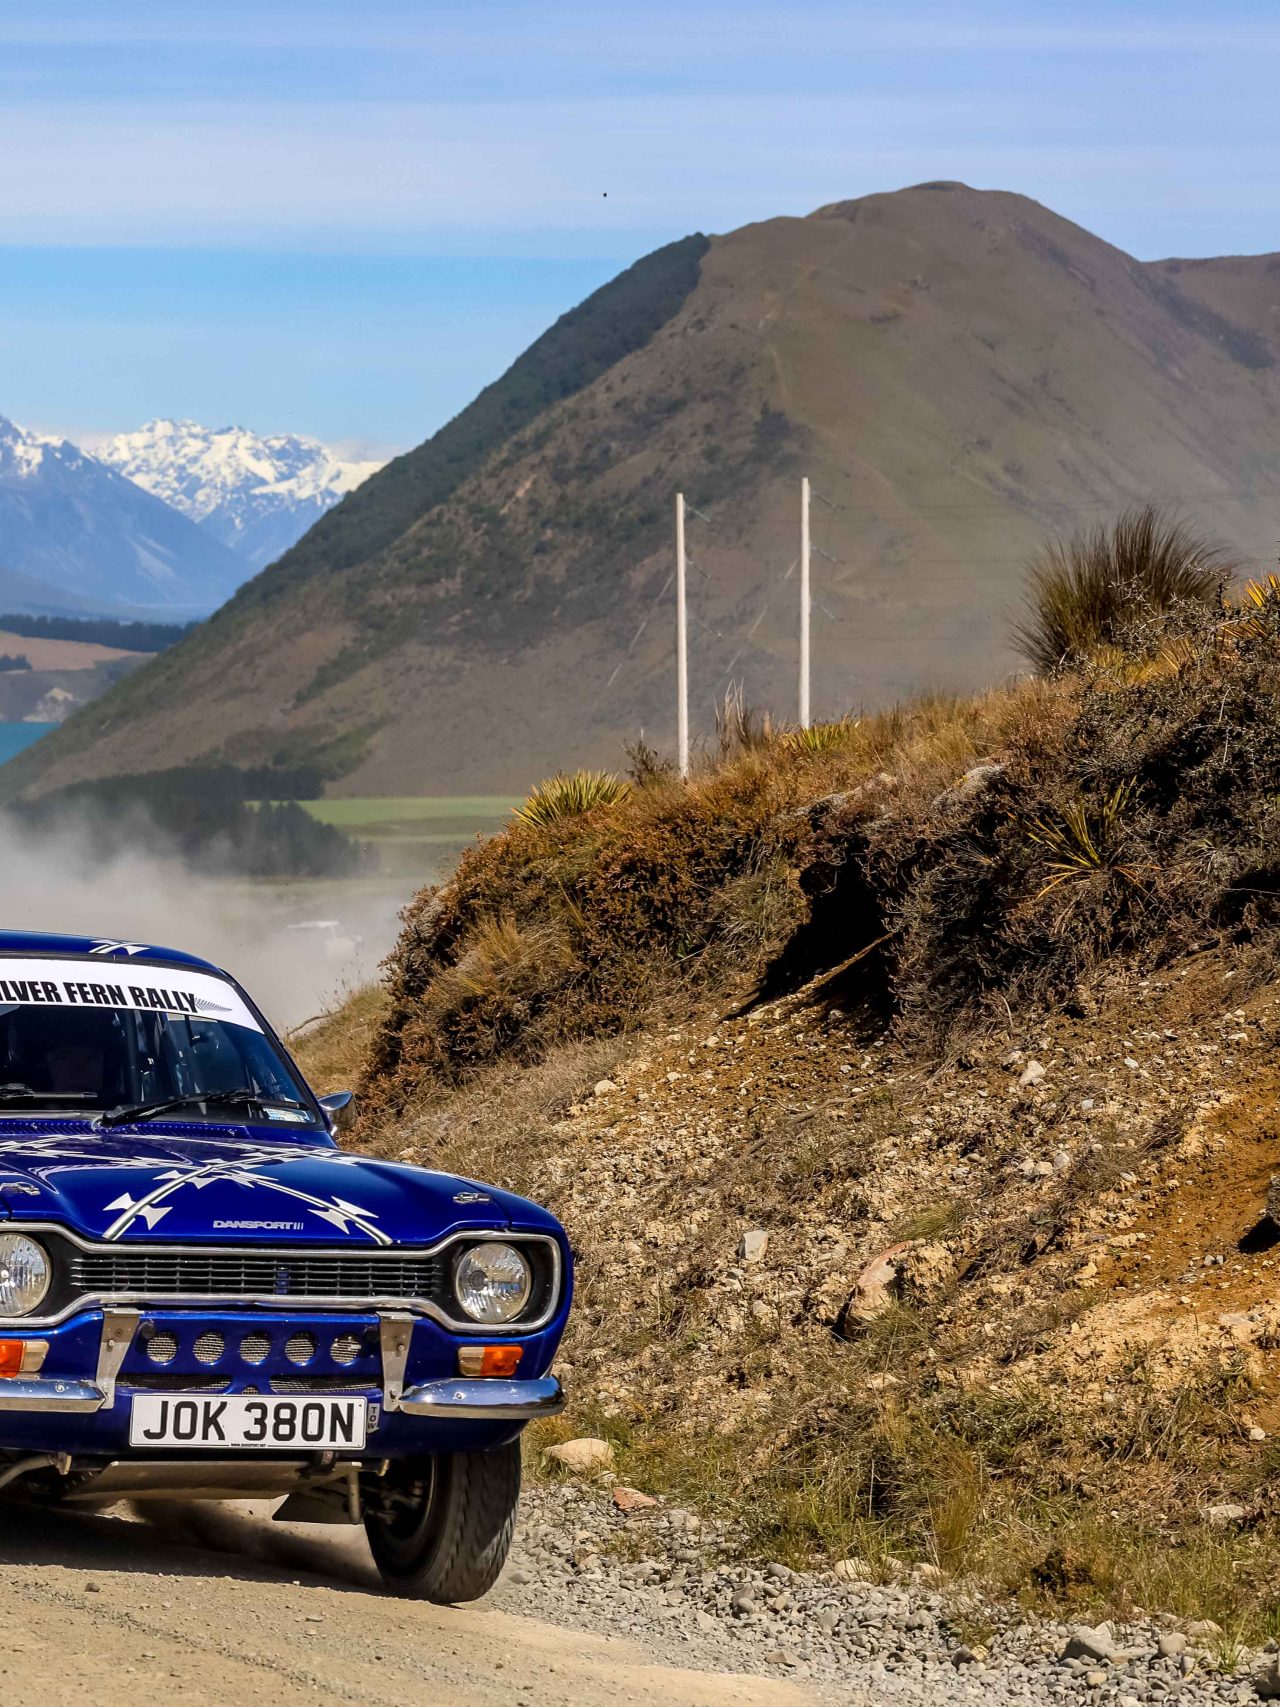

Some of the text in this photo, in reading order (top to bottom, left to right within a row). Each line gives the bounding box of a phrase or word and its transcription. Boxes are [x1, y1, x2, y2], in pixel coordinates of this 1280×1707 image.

[62, 982, 128, 1006] FERN
[128, 986, 199, 1013] RALLY
[143, 1401, 355, 1443] JOK 380N
[367, 1406, 378, 1430] TOW
